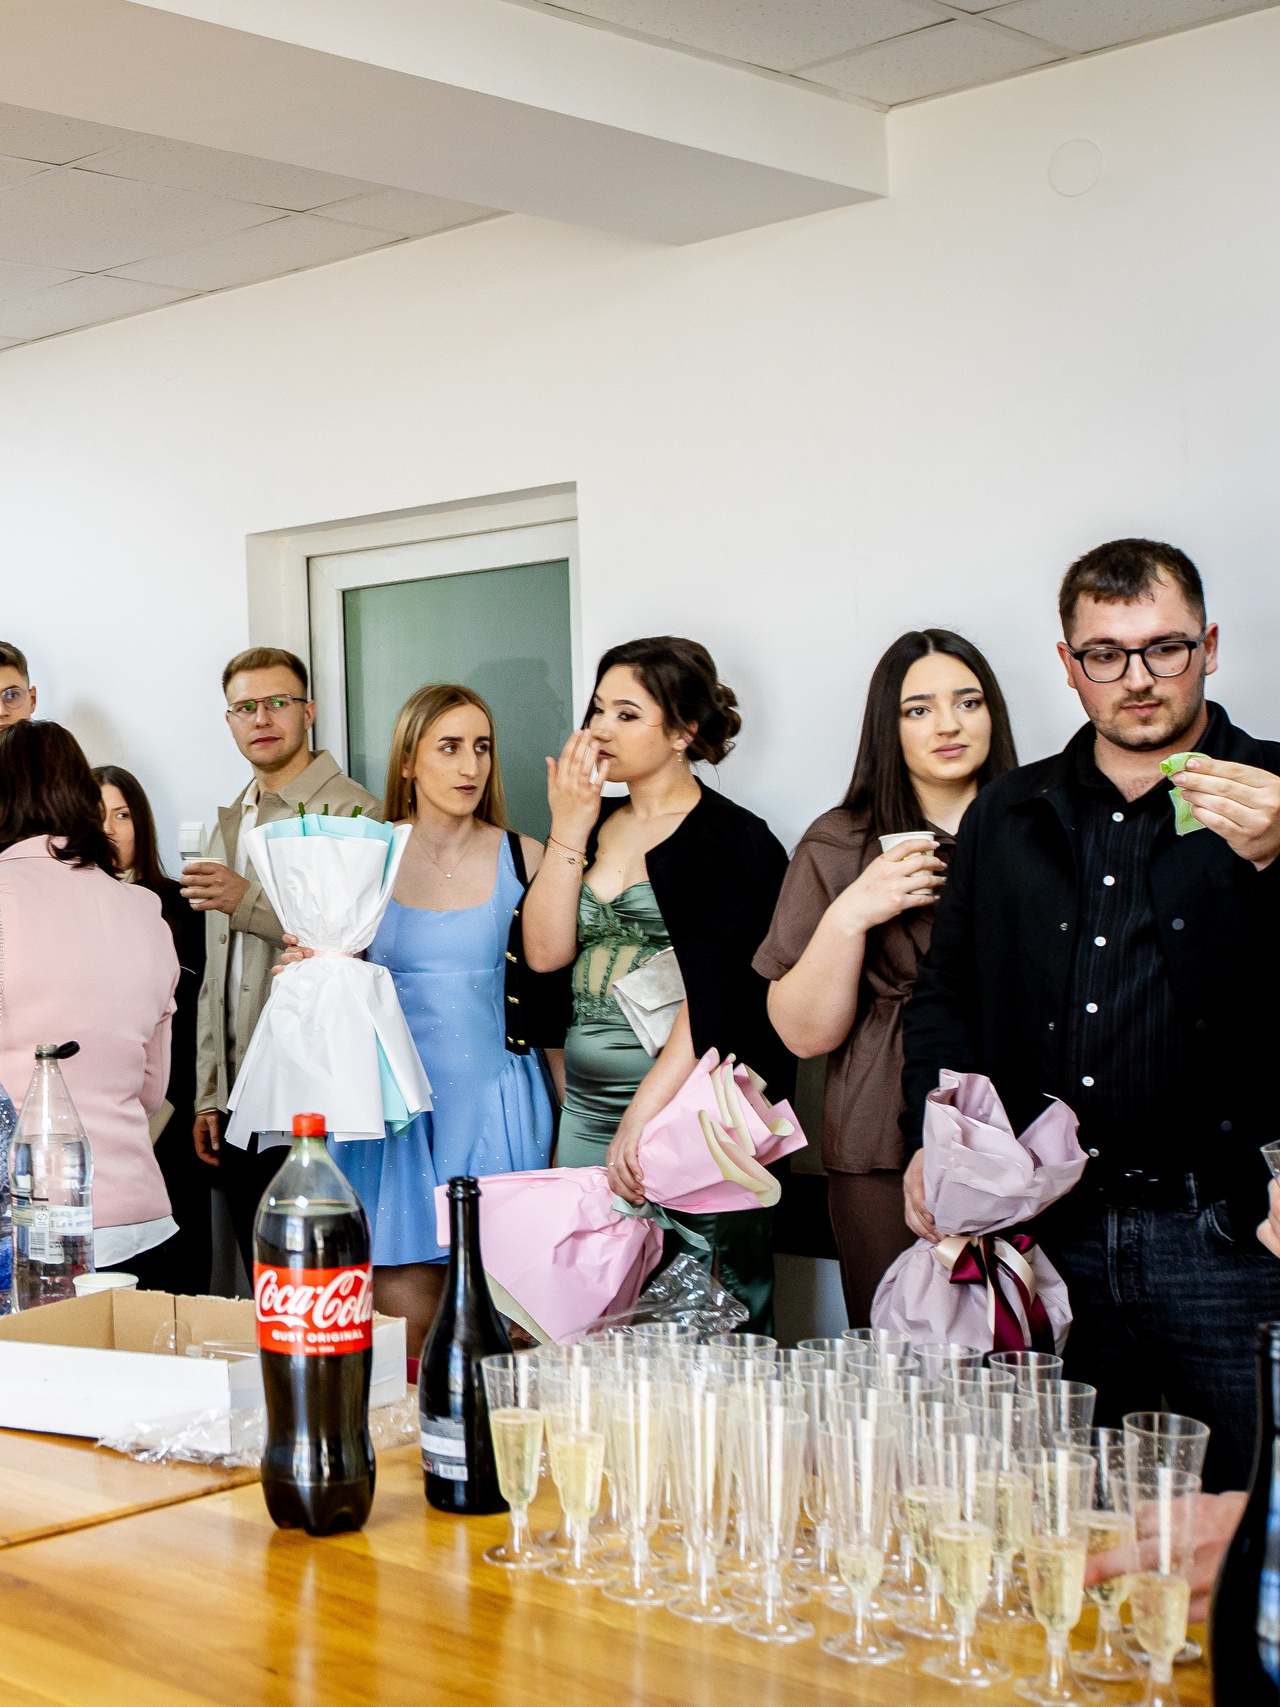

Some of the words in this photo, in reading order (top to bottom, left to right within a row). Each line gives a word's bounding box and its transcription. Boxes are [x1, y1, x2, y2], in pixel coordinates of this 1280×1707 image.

[256, 1269, 372, 1329] Coca-Cola
[271, 1329, 305, 1343] GUST
[306, 1328, 364, 1344] ORIGINAL
